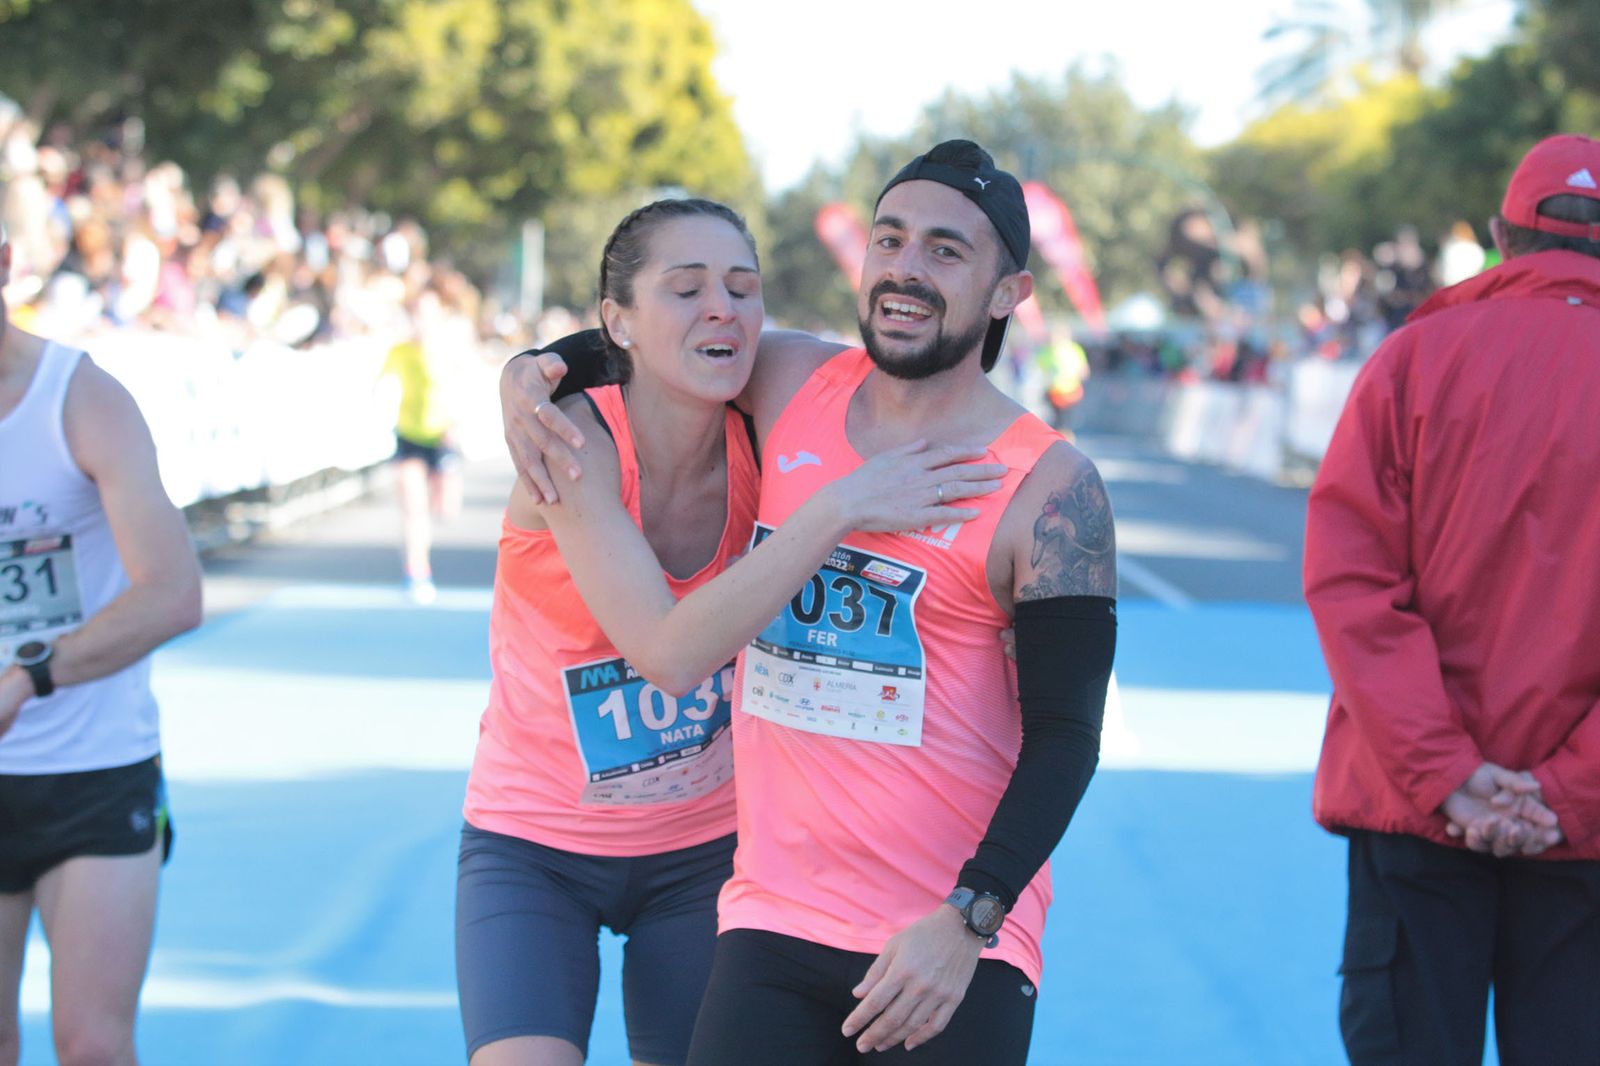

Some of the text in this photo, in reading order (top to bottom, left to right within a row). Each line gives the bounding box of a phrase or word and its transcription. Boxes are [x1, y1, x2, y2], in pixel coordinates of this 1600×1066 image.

[832, 551, 851, 561] atón
[0, 557, 57, 603] 31
[790, 570, 898, 637] 037
[807, 629, 838, 647] FER
[660, 724, 705, 745] NATA
